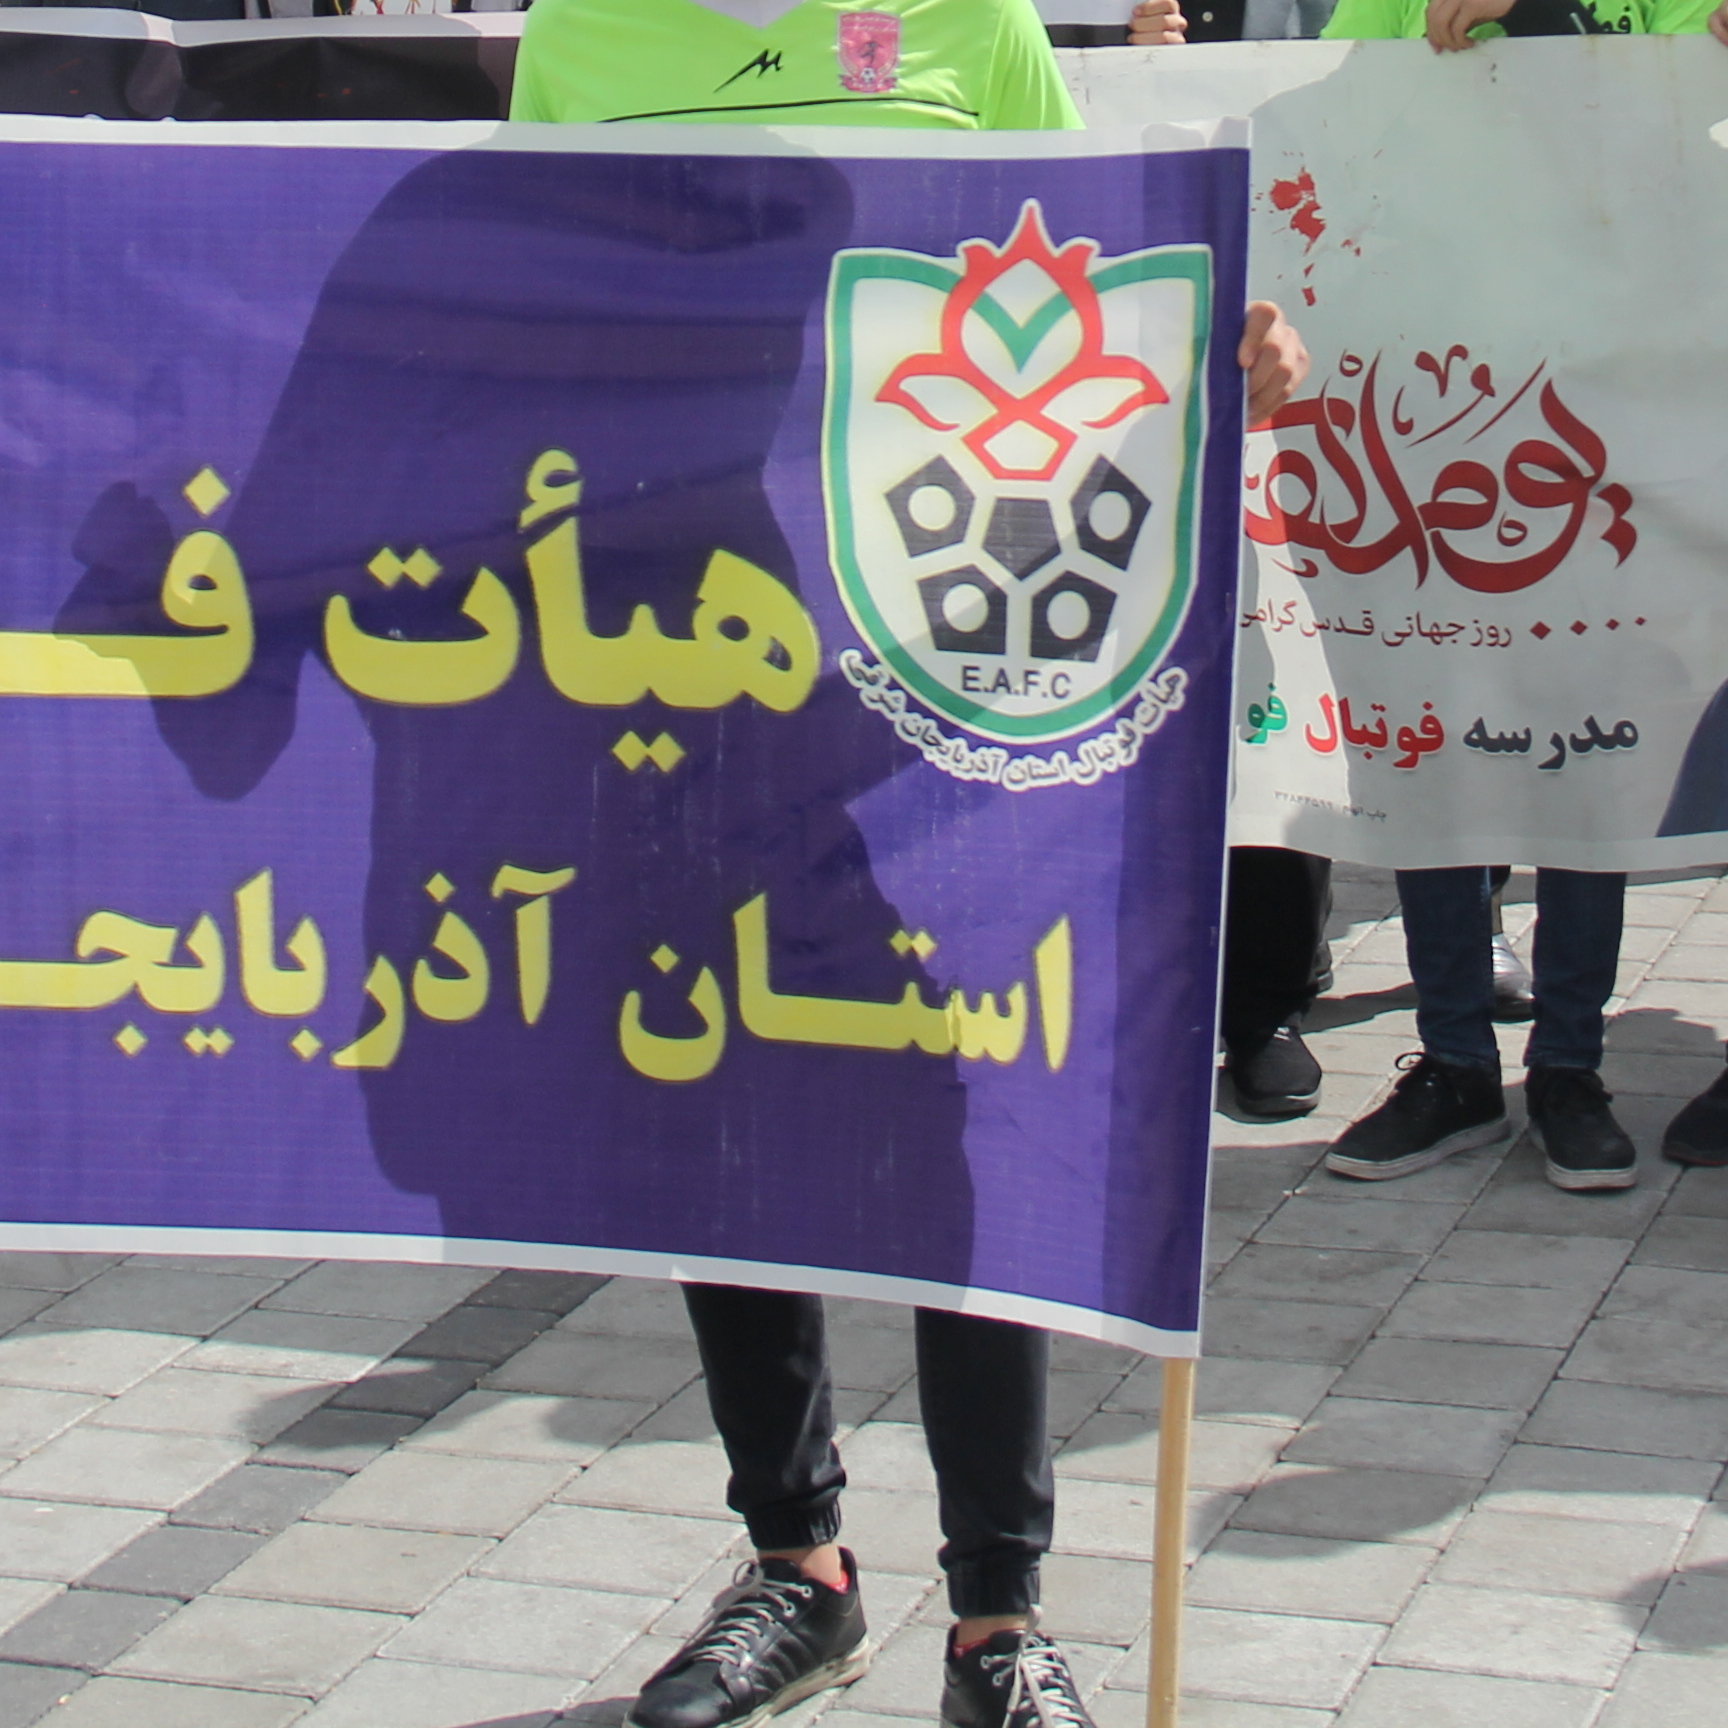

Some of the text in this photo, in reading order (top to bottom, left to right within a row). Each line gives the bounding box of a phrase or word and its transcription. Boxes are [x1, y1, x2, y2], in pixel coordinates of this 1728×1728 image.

[321, 446, 822, 774] هیأت
[1299, 610, 1375, 638] قدس
[1381, 611, 1466, 648] جهانی
[1471, 619, 1512, 648] روز
[843, 652, 904, 714] شرقی
[960, 664, 1073, 700] E.A.F.C
[898, 719, 1006, 779] آذربایجان
[1074, 720, 1138, 780] فوتبال
[1304, 692, 1445, 769] فوتبال
[1462, 714, 1639, 771] مدرسه
[1005, 755, 1070, 787] استان
[616, 893, 1075, 1084] استان
